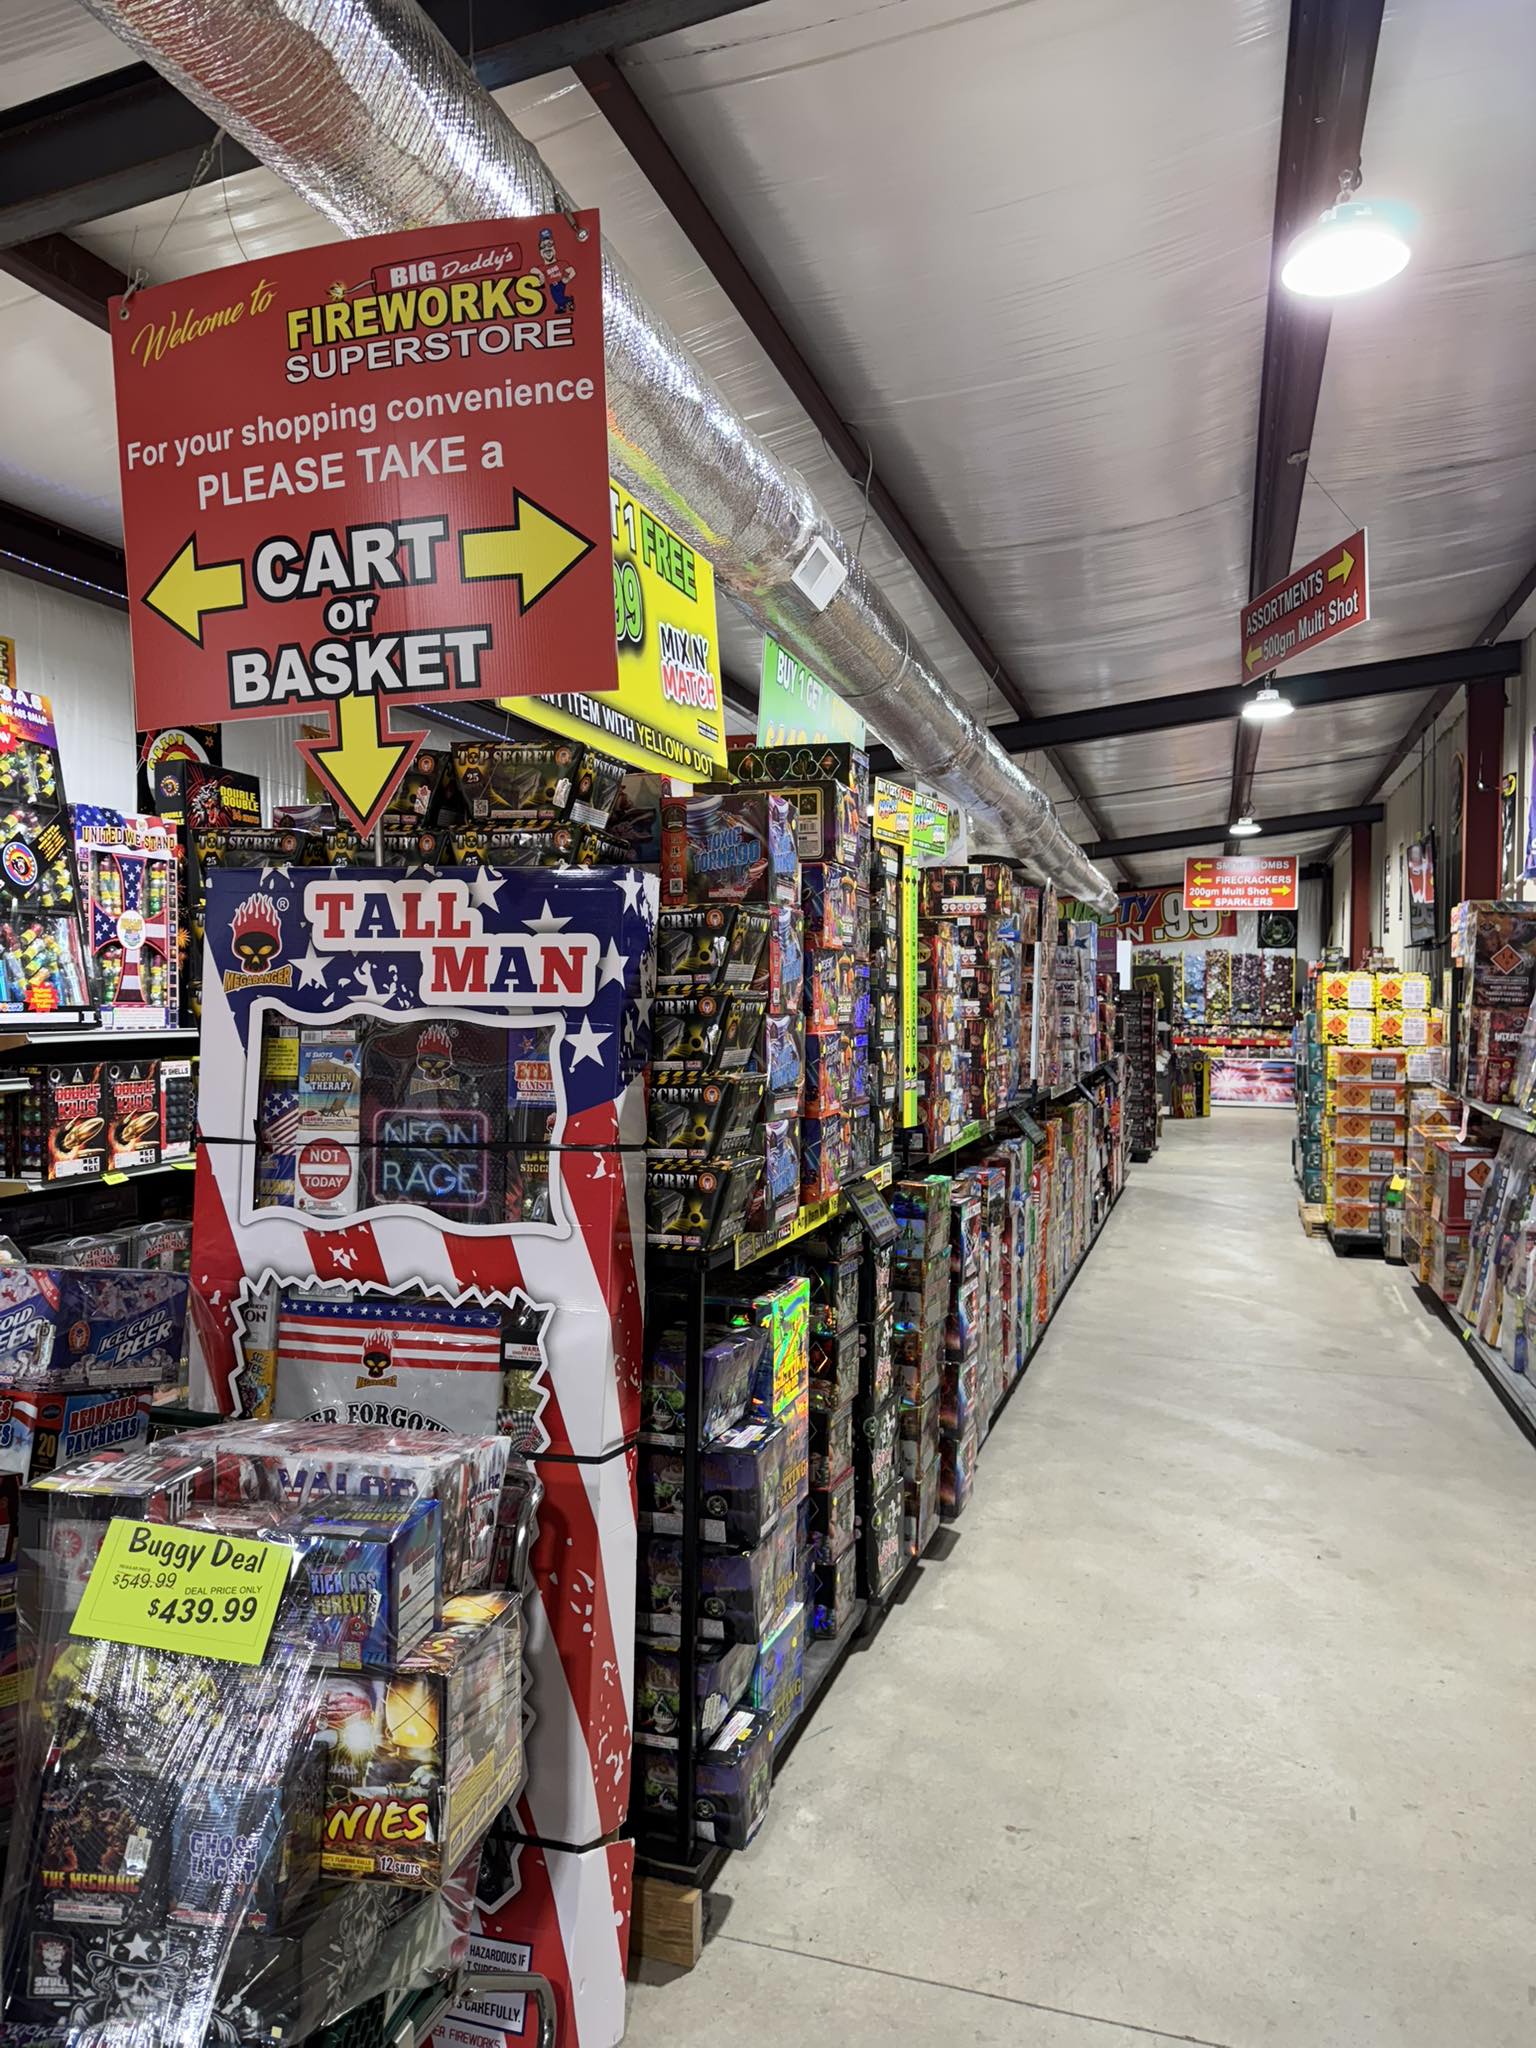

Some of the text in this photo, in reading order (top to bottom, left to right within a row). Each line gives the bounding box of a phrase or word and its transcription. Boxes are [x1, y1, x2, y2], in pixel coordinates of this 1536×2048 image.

[390, 247, 513, 288] BIG Daddy's
[131, 279, 279, 367] Welcome to
[286, 274, 545, 350] FIREWORKS
[285, 318, 574, 383] SUPERSTORE
[127, 377, 594, 470] For your shopping convenience
[198, 435, 505, 510] PLEASE TAKE a
[254, 517, 447, 600] CART
[623, 500, 637, 555] 1
[640, 508, 698, 602] FREE
[326, 597, 376, 632] or
[1246, 569, 1324, 637] ASSORTMENTS
[1263, 589, 1359, 661] 500gm Multi Shot
[659, 624, 689, 664] MIX
[230, 627, 489, 706] BASKET
[661, 663, 717, 709] MATCH
[777, 647, 798, 695] BUY
[807, 675, 824, 712] GET
[567, 692, 601, 726] ITEM
[602, 705, 636, 742] WITH
[636, 722, 684, 766] YELLOW
[693, 751, 714, 777] DOT
[148, 733, 186, 770] GREAT
[457, 750, 554, 765] TOP SECRET
[467, 772, 479, 783] 25
[220, 785, 256, 802] DOUBLE
[223, 796, 260, 812] DOUBLE
[82, 825, 124, 846] UNITED
[126, 827, 141, 849] WE
[144, 835, 176, 850] STAND
[198, 835, 282, 849] TOP SECRET
[327, 836, 356, 849] TOP
[456, 833, 553, 849] TOP SECRET
[706, 826, 745, 849] TOXIC
[693, 840, 761, 874] TORNADO
[1254, 861, 1290, 870] OMBS
[1189, 886, 1270, 897] 200gm Multi Shot
[1215, 876, 1292, 885] FIRECRACKERS
[1214, 897, 1274, 907] SPARKLERS
[315, 892, 471, 939] TALL
[224, 968, 293, 994] MEGABANGER
[431, 946, 588, 994] MAN
[168, 1068, 189, 1076] SHELLS
[304, 1073, 348, 1083] SUNSHINE
[55, 1083, 101, 1102] DOUBLE
[113, 1079, 156, 1098] DOUBLE
[311, 1081, 353, 1091] THERAPY
[57, 1100, 99, 1120] KILLS
[116, 1095, 154, 1114] KILLS
[384, 1121, 478, 1148] NEON
[310, 1149, 341, 1163] NOT
[304, 1176, 344, 1188] TODAY
[382, 1160, 479, 1196] RAGE
[97, 1308, 167, 1357] ICE COLD
[113, 1320, 173, 1366] BEER
[69, 1395, 137, 1434] REDNECKS
[39, 1433, 57, 1458] 20
[65, 1417, 139, 1458] PAYCHECKS
[166, 1475, 194, 1520] THE
[128, 1526, 207, 1573] Buggy
[210, 1538, 269, 1574] Deal
[112, 1572, 178, 1590] $549.99
[184, 1585, 264, 1595] DEAL PRICE ONLY
[309, 1572, 377, 1594] KICK ASS
[147, 1596, 258, 1625] $439.99
[325, 1802, 429, 1841] NIES
[188, 1831, 262, 1859] GHOST
[380, 1857, 393, 1872] 12
[394, 1863, 421, 1876] SHOTS
[42, 1870, 141, 1893] THE MECHANIC
[469, 1944, 518, 1966] HAZARDOUS
[518, 1953, 527, 1967] IF
[34, 1976, 70, 1988] SKULL
[464, 2001, 522, 2023] CAREFULLY.
[448, 2028, 501, 2048] FIREWORKS
